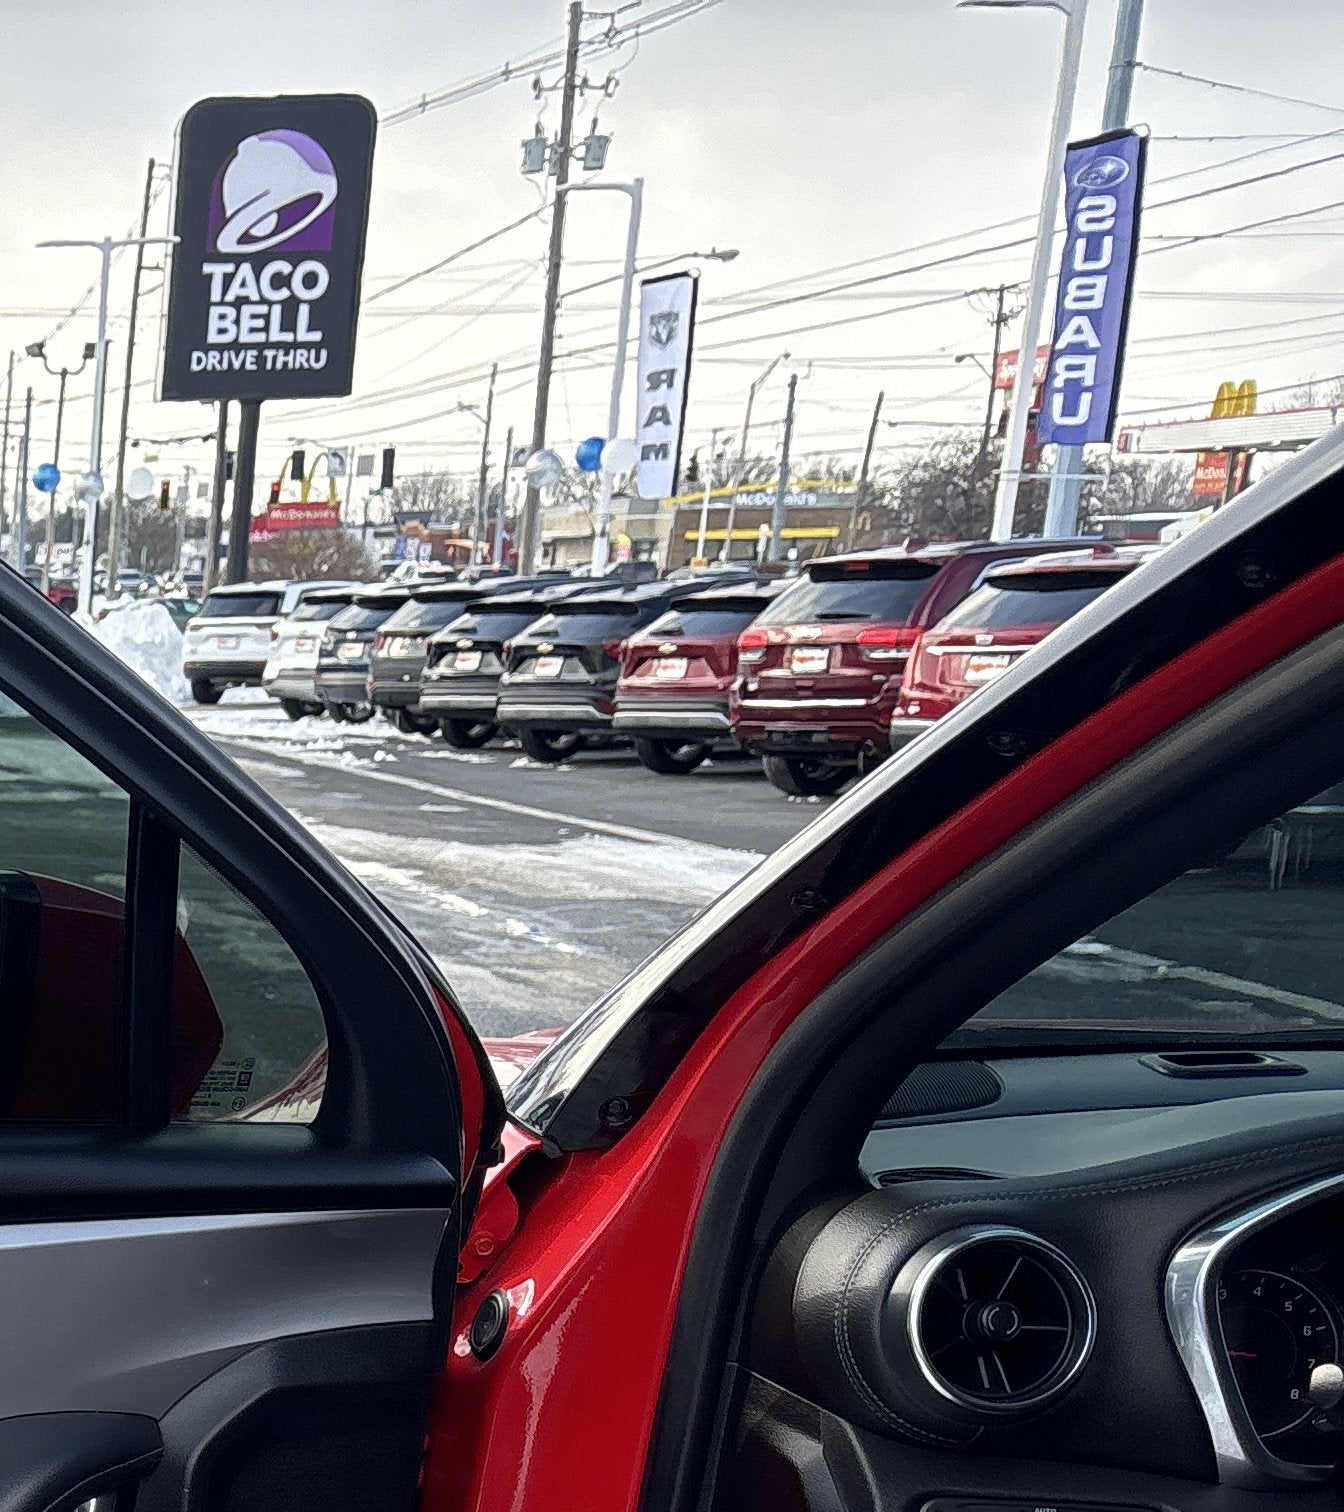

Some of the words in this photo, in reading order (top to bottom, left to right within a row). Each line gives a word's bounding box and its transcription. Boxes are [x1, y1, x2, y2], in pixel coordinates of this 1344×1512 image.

[202, 260, 330, 302] TACO
[206, 303, 323, 344] BELL
[190, 350, 258, 372] DRIVE
[262, 348, 328, 370] THRU
[1253, 1286, 1262, 1297] 4
[1284, 1301, 1293, 1312] 5
[1303, 1325, 1312, 1337] 6
